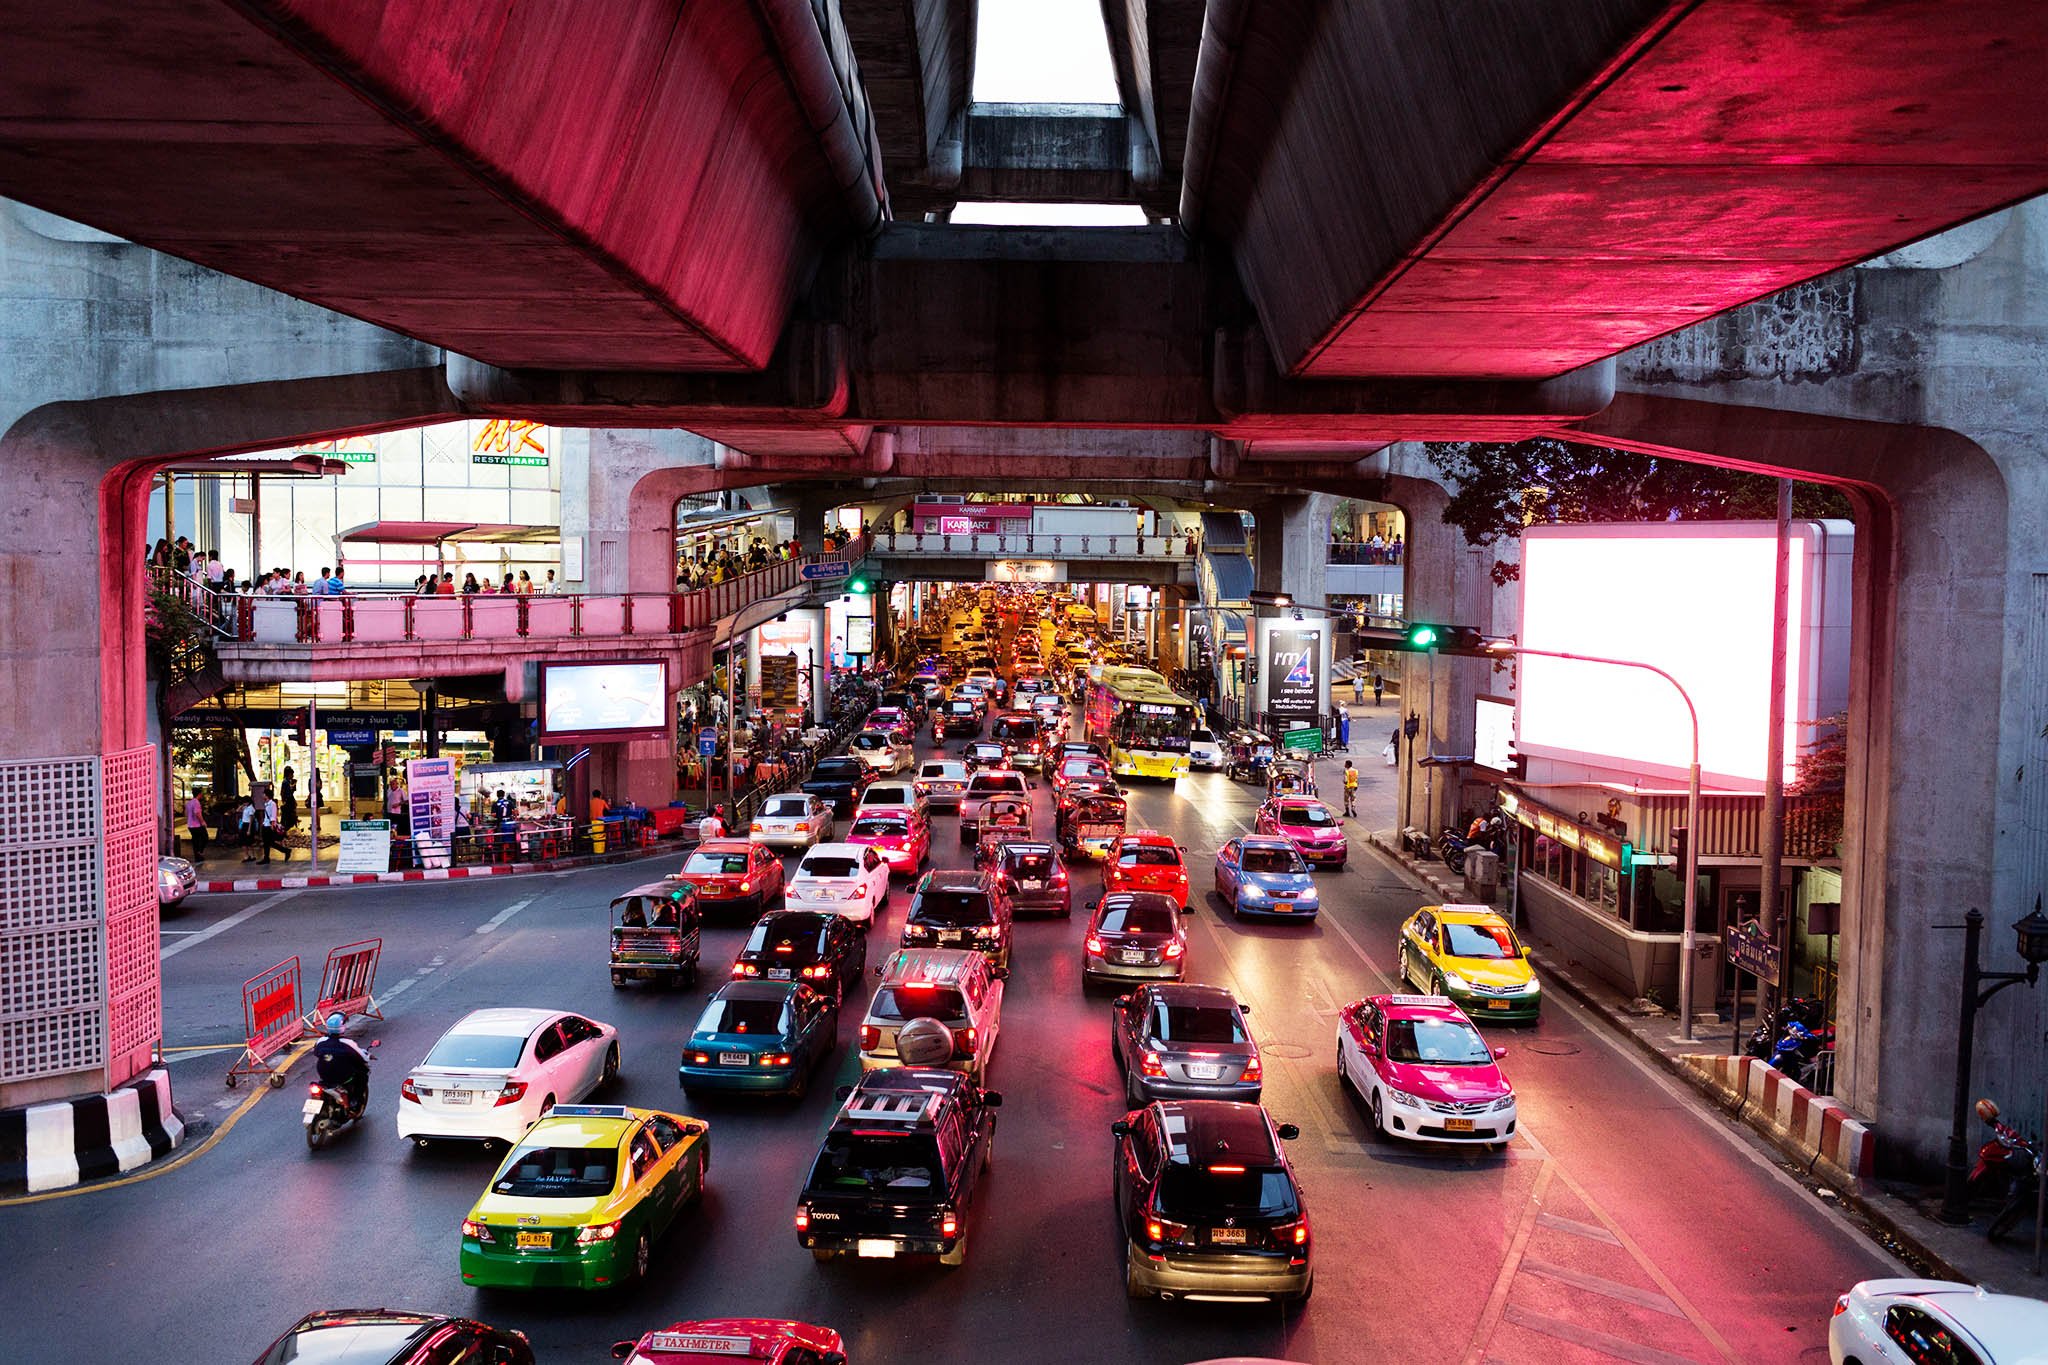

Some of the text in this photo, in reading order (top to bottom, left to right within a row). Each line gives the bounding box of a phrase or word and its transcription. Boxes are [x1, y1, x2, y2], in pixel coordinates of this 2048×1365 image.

[322, 453, 375, 462] AURANTS
[474, 456, 548, 466] RESTAURANTS
[947, 520, 990, 529] KARMART
[174, 714, 201, 724] beauty
[327, 716, 365, 725] pharmacy
[811, 1212, 840, 1220] TOYOTA
[534, 1234, 549, 1242] 8751
[1226, 1229, 1245, 1238] 3663
[663, 1337, 731, 1350] TAXI-METER
